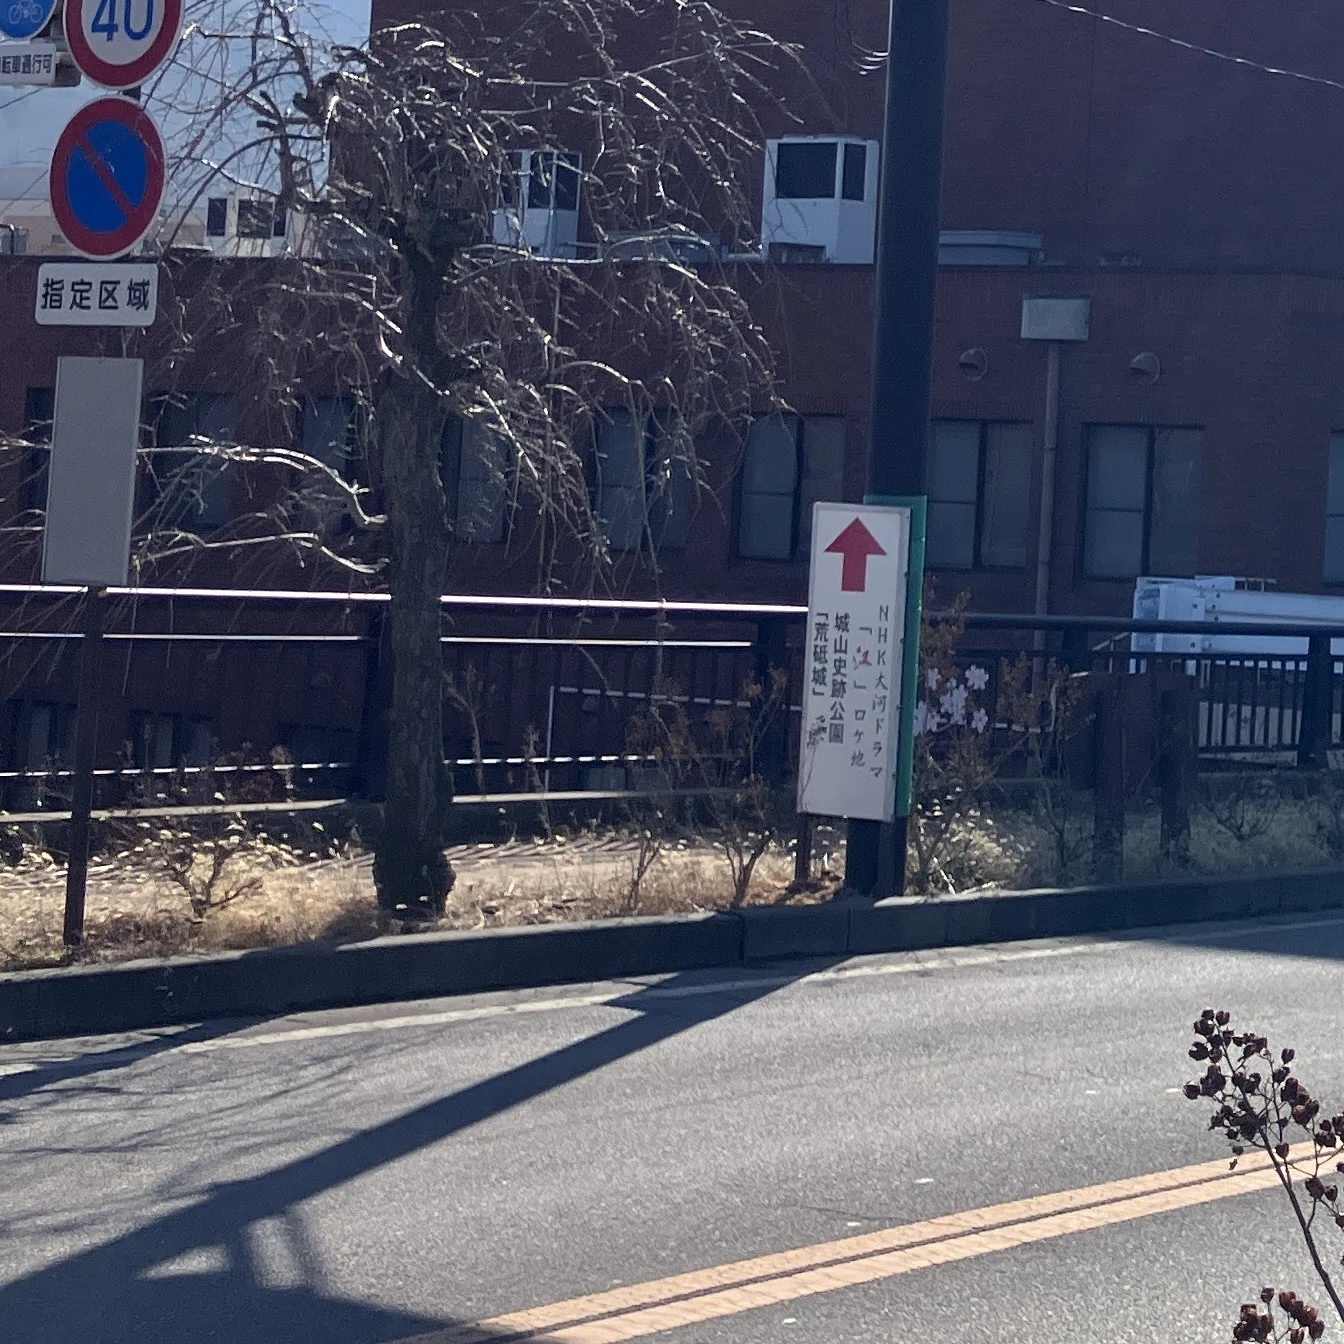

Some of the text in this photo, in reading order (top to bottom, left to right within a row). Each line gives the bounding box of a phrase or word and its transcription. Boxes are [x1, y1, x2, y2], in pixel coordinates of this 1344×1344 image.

[0, 53, 53, 74] 転車通行可
[41, 276, 151, 312] 指定区域
[828, 612, 851, 744] 城山史跡公園
[870, 605, 890, 778] NHK大河ドラマ
